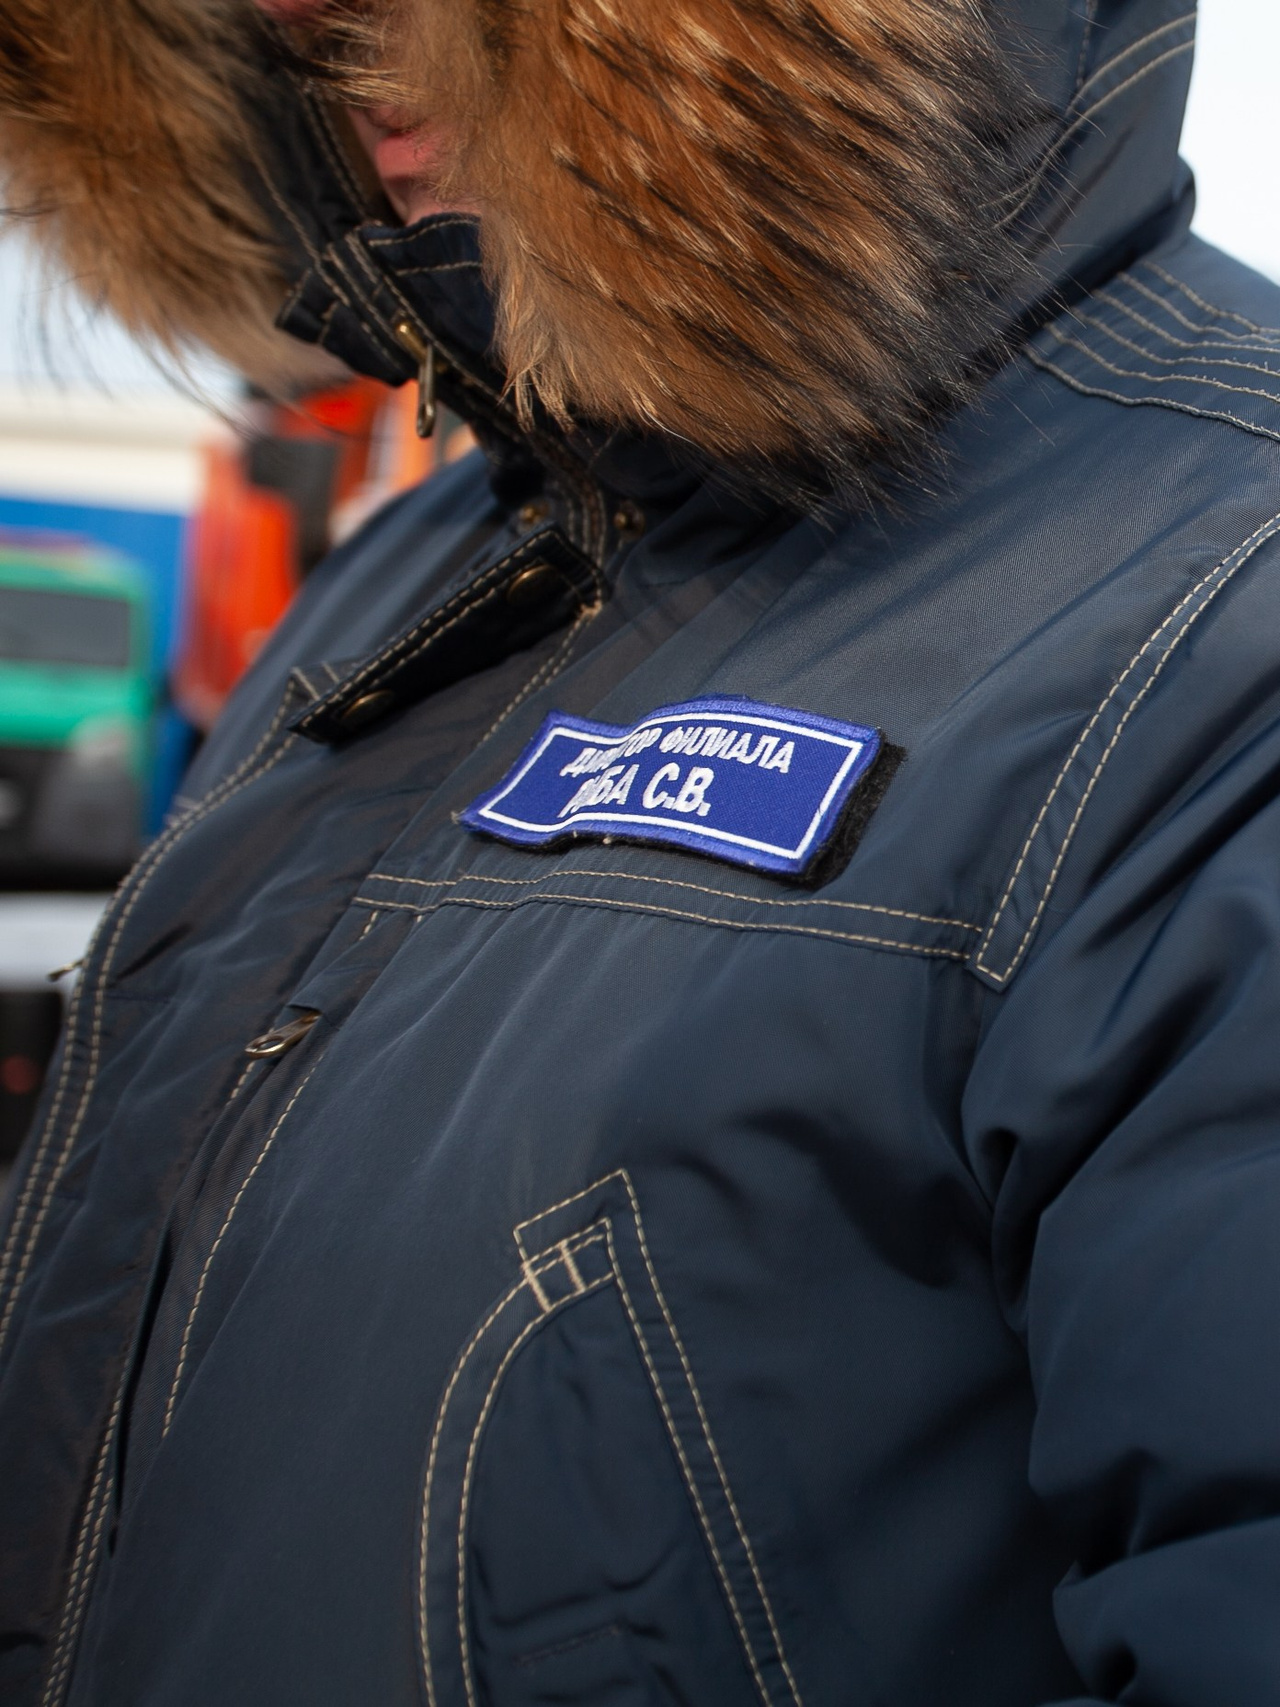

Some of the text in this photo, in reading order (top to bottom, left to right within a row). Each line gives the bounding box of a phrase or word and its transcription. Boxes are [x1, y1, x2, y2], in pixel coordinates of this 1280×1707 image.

[559, 726, 796, 778] ДИТОР ФИЛИАЛА
[642, 762, 715, 817] С.В.
